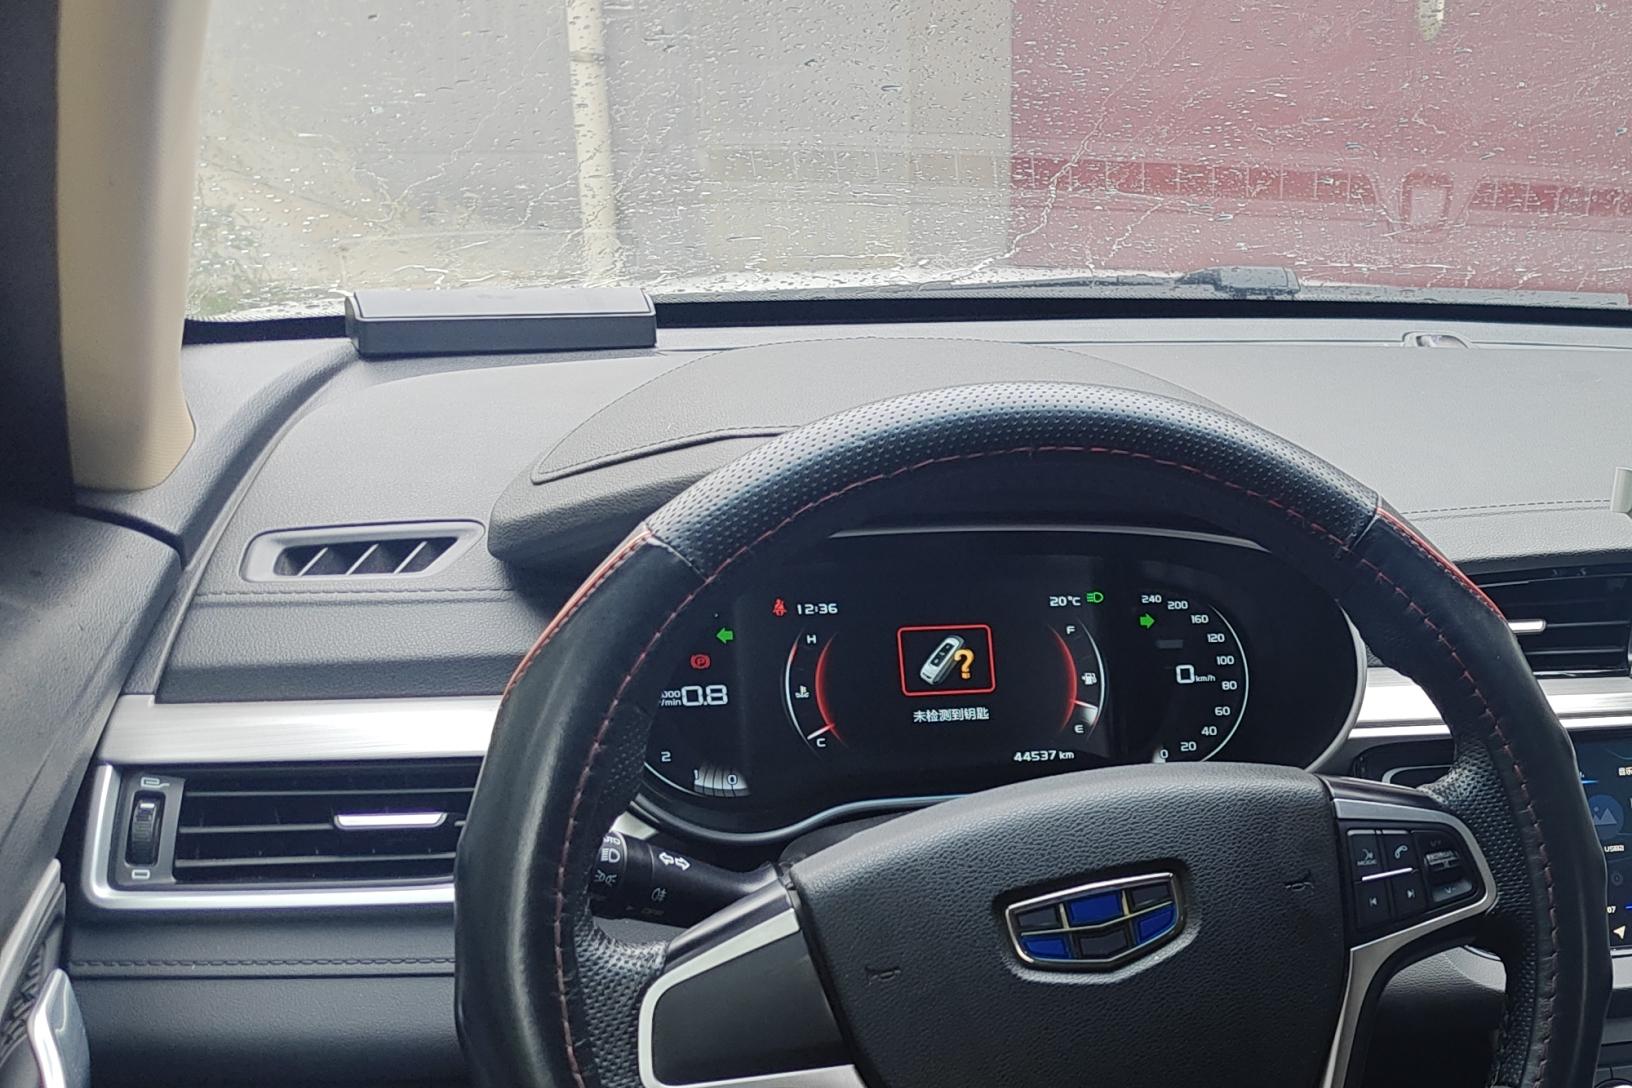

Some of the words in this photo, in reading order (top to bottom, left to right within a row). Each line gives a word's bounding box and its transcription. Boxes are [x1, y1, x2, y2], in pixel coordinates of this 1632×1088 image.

[1141, 594, 1162, 604] 240
[796, 603, 838, 615] 12:36
[1167, 600, 1188, 611] 200
[1191, 614, 1209, 625] 160
[1066, 626, 1075, 635] F
[806, 634, 817, 644] H
[1207, 633, 1225, 643] 120
[1216, 655, 1234, 666] 100
[1176, 664, 1195, 684] 0
[1195, 673, 1216, 683] km/h
[1221, 680, 1238, 691] 80
[681, 684, 728, 706] 0.8
[913, 706, 990, 723] 未检测到钥匙
[1214, 705, 1230, 716] 60
[1074, 724, 1084, 733] E
[1201, 726, 1218, 736] 40
[1180, 741, 1197, 752] 20
[661, 751, 671, 762] 2
[1013, 750, 1056, 762] 44537
[1058, 750, 1075, 760] km
[1159, 749, 1168, 760] 0
[726, 774, 737, 784] 0
